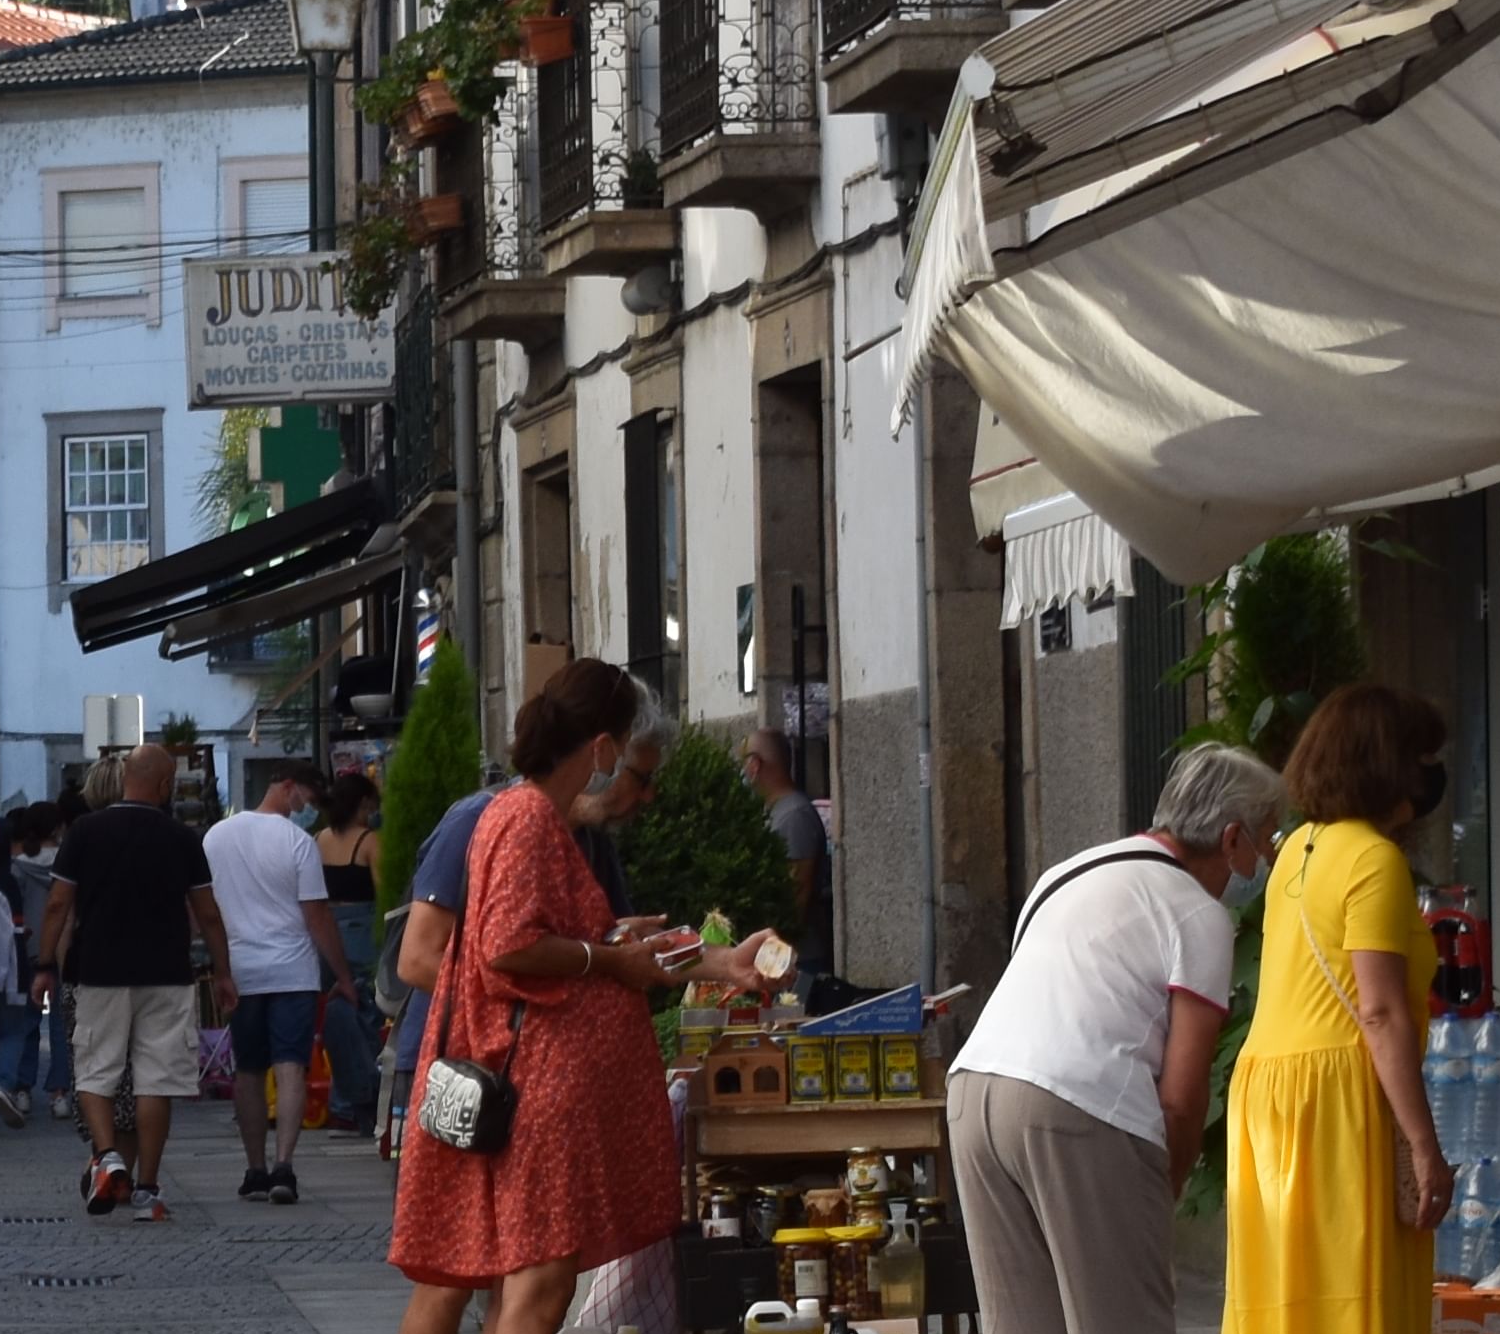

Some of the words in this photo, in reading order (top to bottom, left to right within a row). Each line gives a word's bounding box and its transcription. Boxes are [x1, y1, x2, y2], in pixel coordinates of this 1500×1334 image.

[202, 325, 279, 347] LOUÇAS
[247, 342, 348, 364] CARPETES
[205, 364, 279, 386] MÓVEIS
[291, 362, 389, 382] COZINHAS
